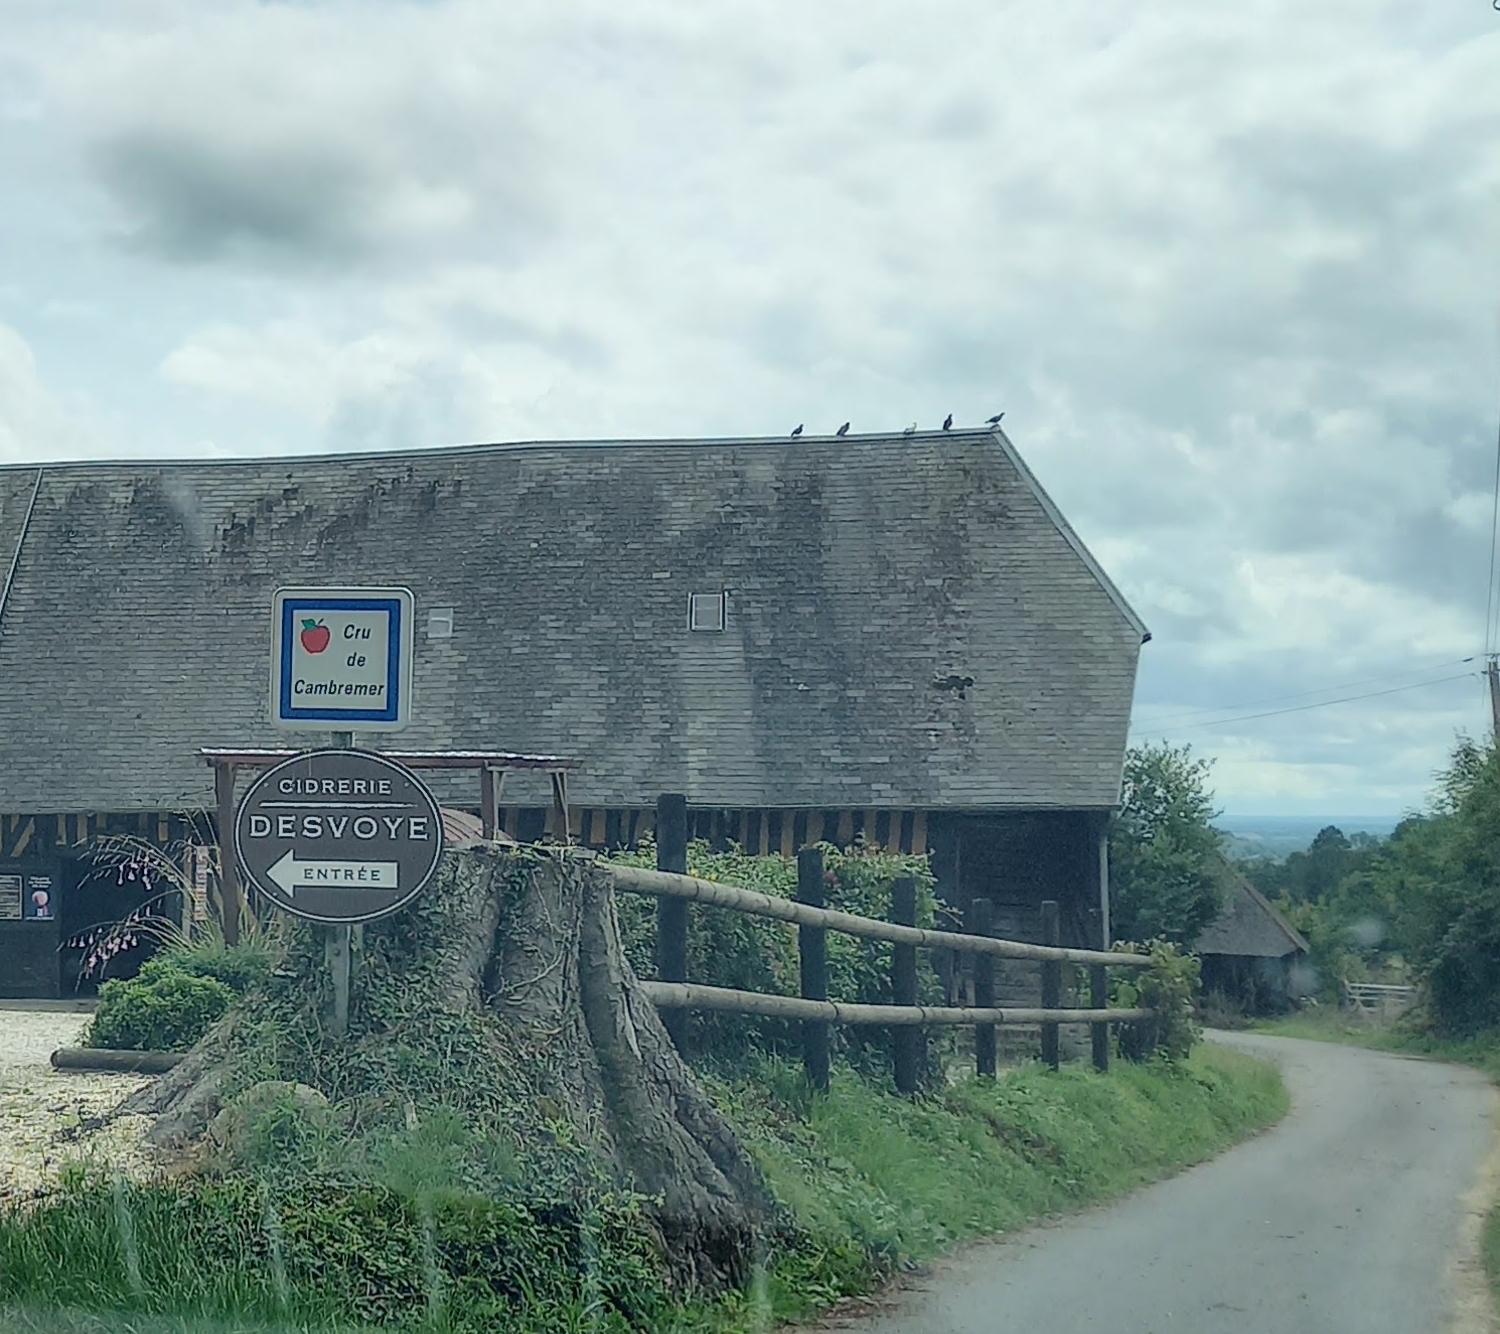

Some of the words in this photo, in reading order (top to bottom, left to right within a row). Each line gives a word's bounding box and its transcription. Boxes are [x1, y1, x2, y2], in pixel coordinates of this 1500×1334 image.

[343, 624, 371, 640] Cru
[346, 652, 366, 667] de
[293, 680, 384, 697] Cambremer
[279, 779, 393, 795] CIDRERIE
[250, 816, 429, 840] DESVOYE
[304, 866, 380, 881] ENTRÉE
